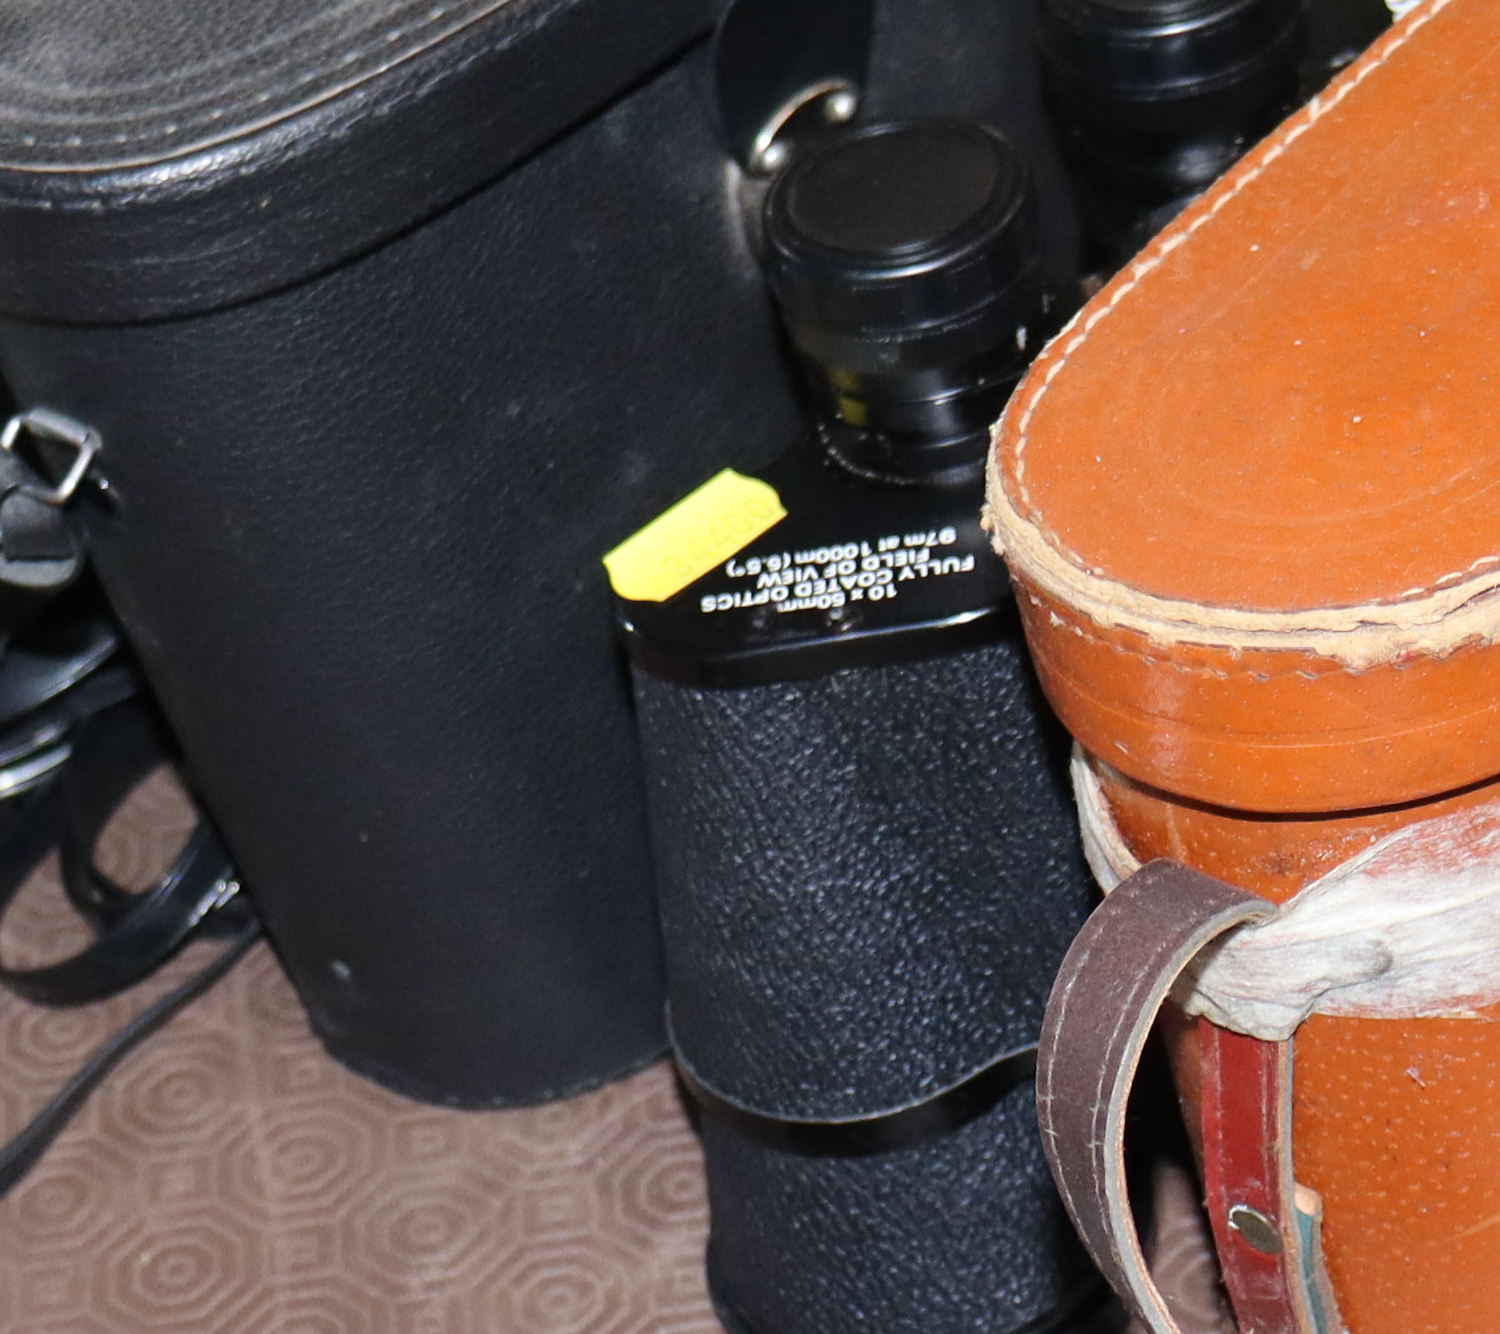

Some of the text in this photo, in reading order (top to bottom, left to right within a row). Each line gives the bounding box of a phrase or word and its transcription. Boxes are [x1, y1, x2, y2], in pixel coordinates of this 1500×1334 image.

[794, 541, 873, 565] 1000m
[878, 535, 900, 552] at
[701, 554, 975, 613] FULLY COATED OPTICS
[757, 547, 930, 589] FIELD OF VIEW
[777, 582, 898, 613] 10 x 50mm
